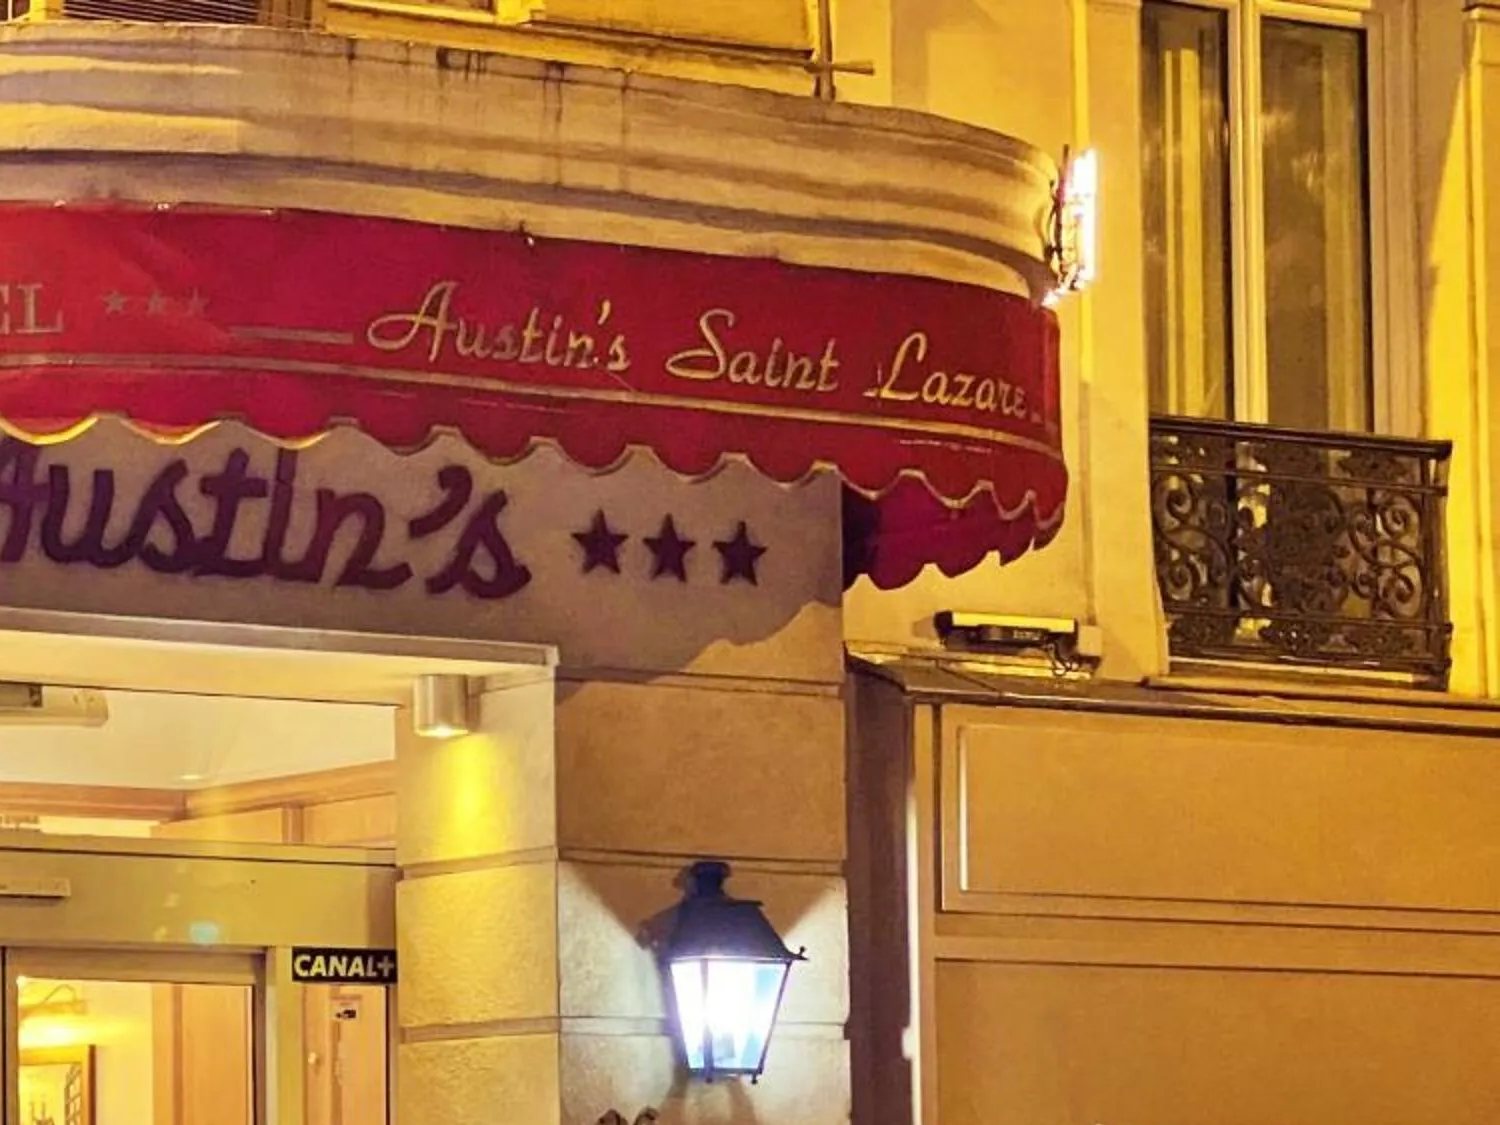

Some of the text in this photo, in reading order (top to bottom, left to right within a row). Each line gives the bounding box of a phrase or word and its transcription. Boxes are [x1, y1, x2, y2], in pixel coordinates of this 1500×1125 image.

[367, 281, 631, 370] Austin's
[665, 309, 840, 391] Saint
[863, 332, 1028, 419] Lazare
[293, 954, 395, 977] CANAL+
